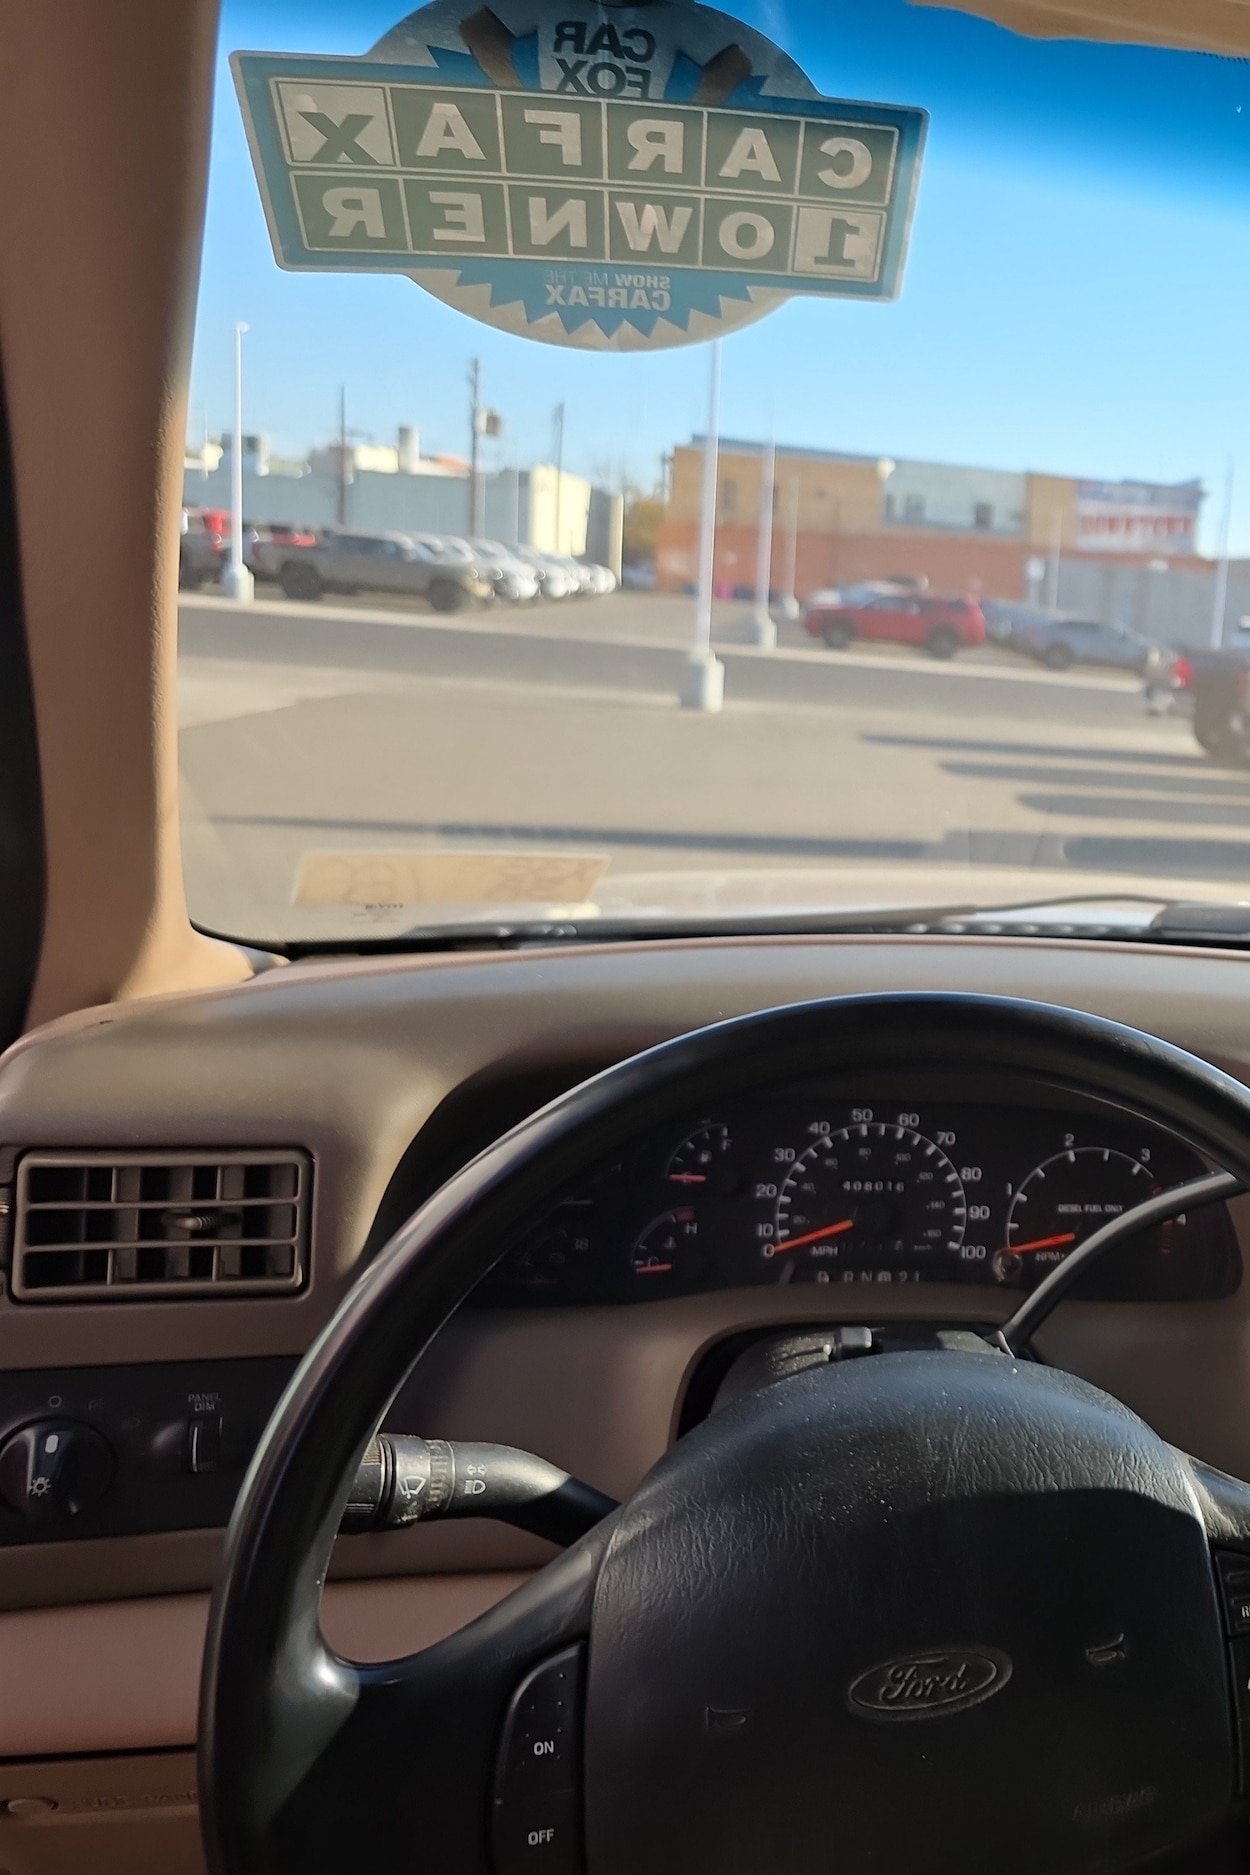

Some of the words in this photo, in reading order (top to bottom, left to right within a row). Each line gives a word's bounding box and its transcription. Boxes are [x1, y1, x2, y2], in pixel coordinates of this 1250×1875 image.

[851, 1108, 874, 1122] 50
[898, 1112, 920, 1127] 60
[808, 1121, 830, 1134] 40
[937, 1131, 956, 1145] 70
[1065, 1132, 1075, 1147] 2
[774, 1147, 796, 1162] 30
[961, 1166, 983, 1181] 80
[755, 1183, 778, 1198] 20
[969, 1205, 991, 1220] 90
[757, 1223, 774, 1237] 10
[960, 1245, 987, 1259] 100
[879, 1656, 968, 1703] Ford
[533, 1740, 555, 1756] ON
[528, 1828, 555, 1846] OFF
